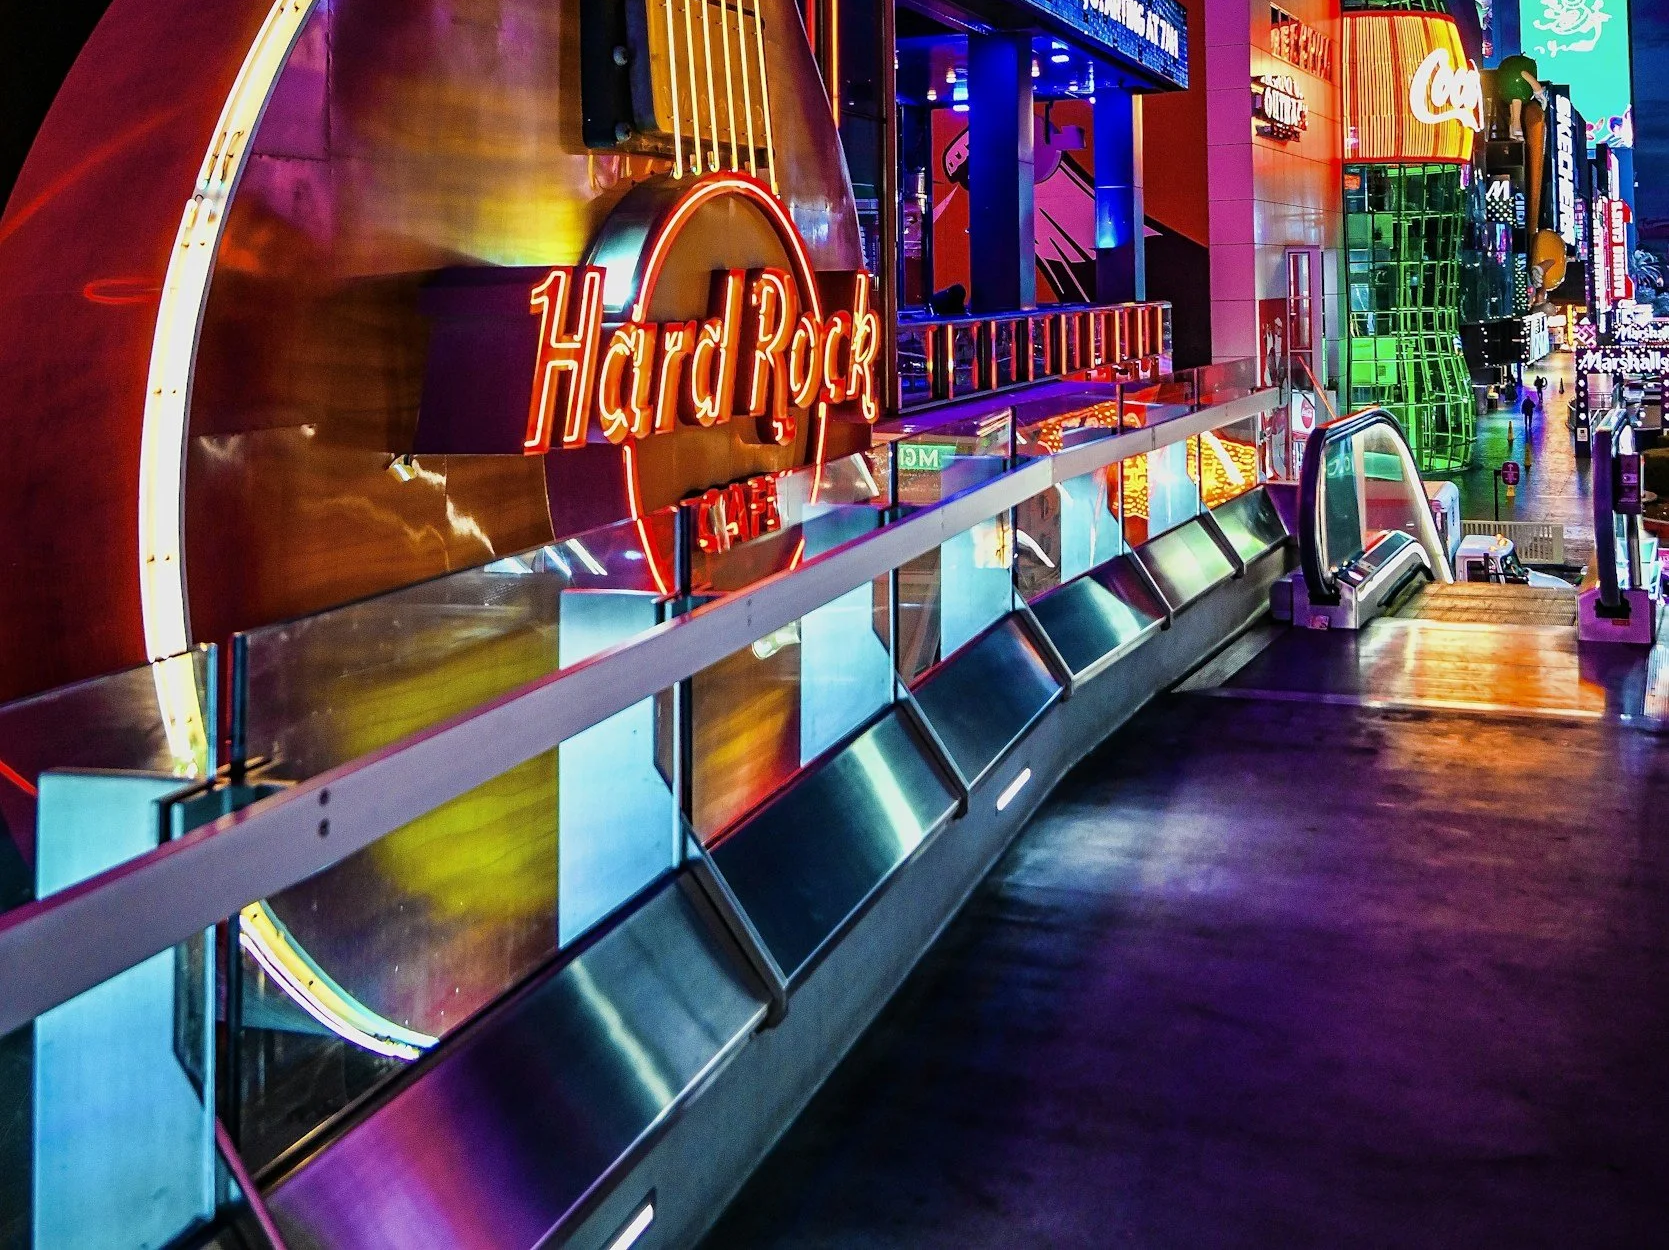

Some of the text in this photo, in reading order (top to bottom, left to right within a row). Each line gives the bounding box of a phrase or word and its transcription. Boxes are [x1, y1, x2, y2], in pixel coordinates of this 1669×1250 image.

[1146, 10, 1160, 47] AT
[523, 264, 881, 456] Hard Rock
[1578, 349, 1669, 372] Marshalls
